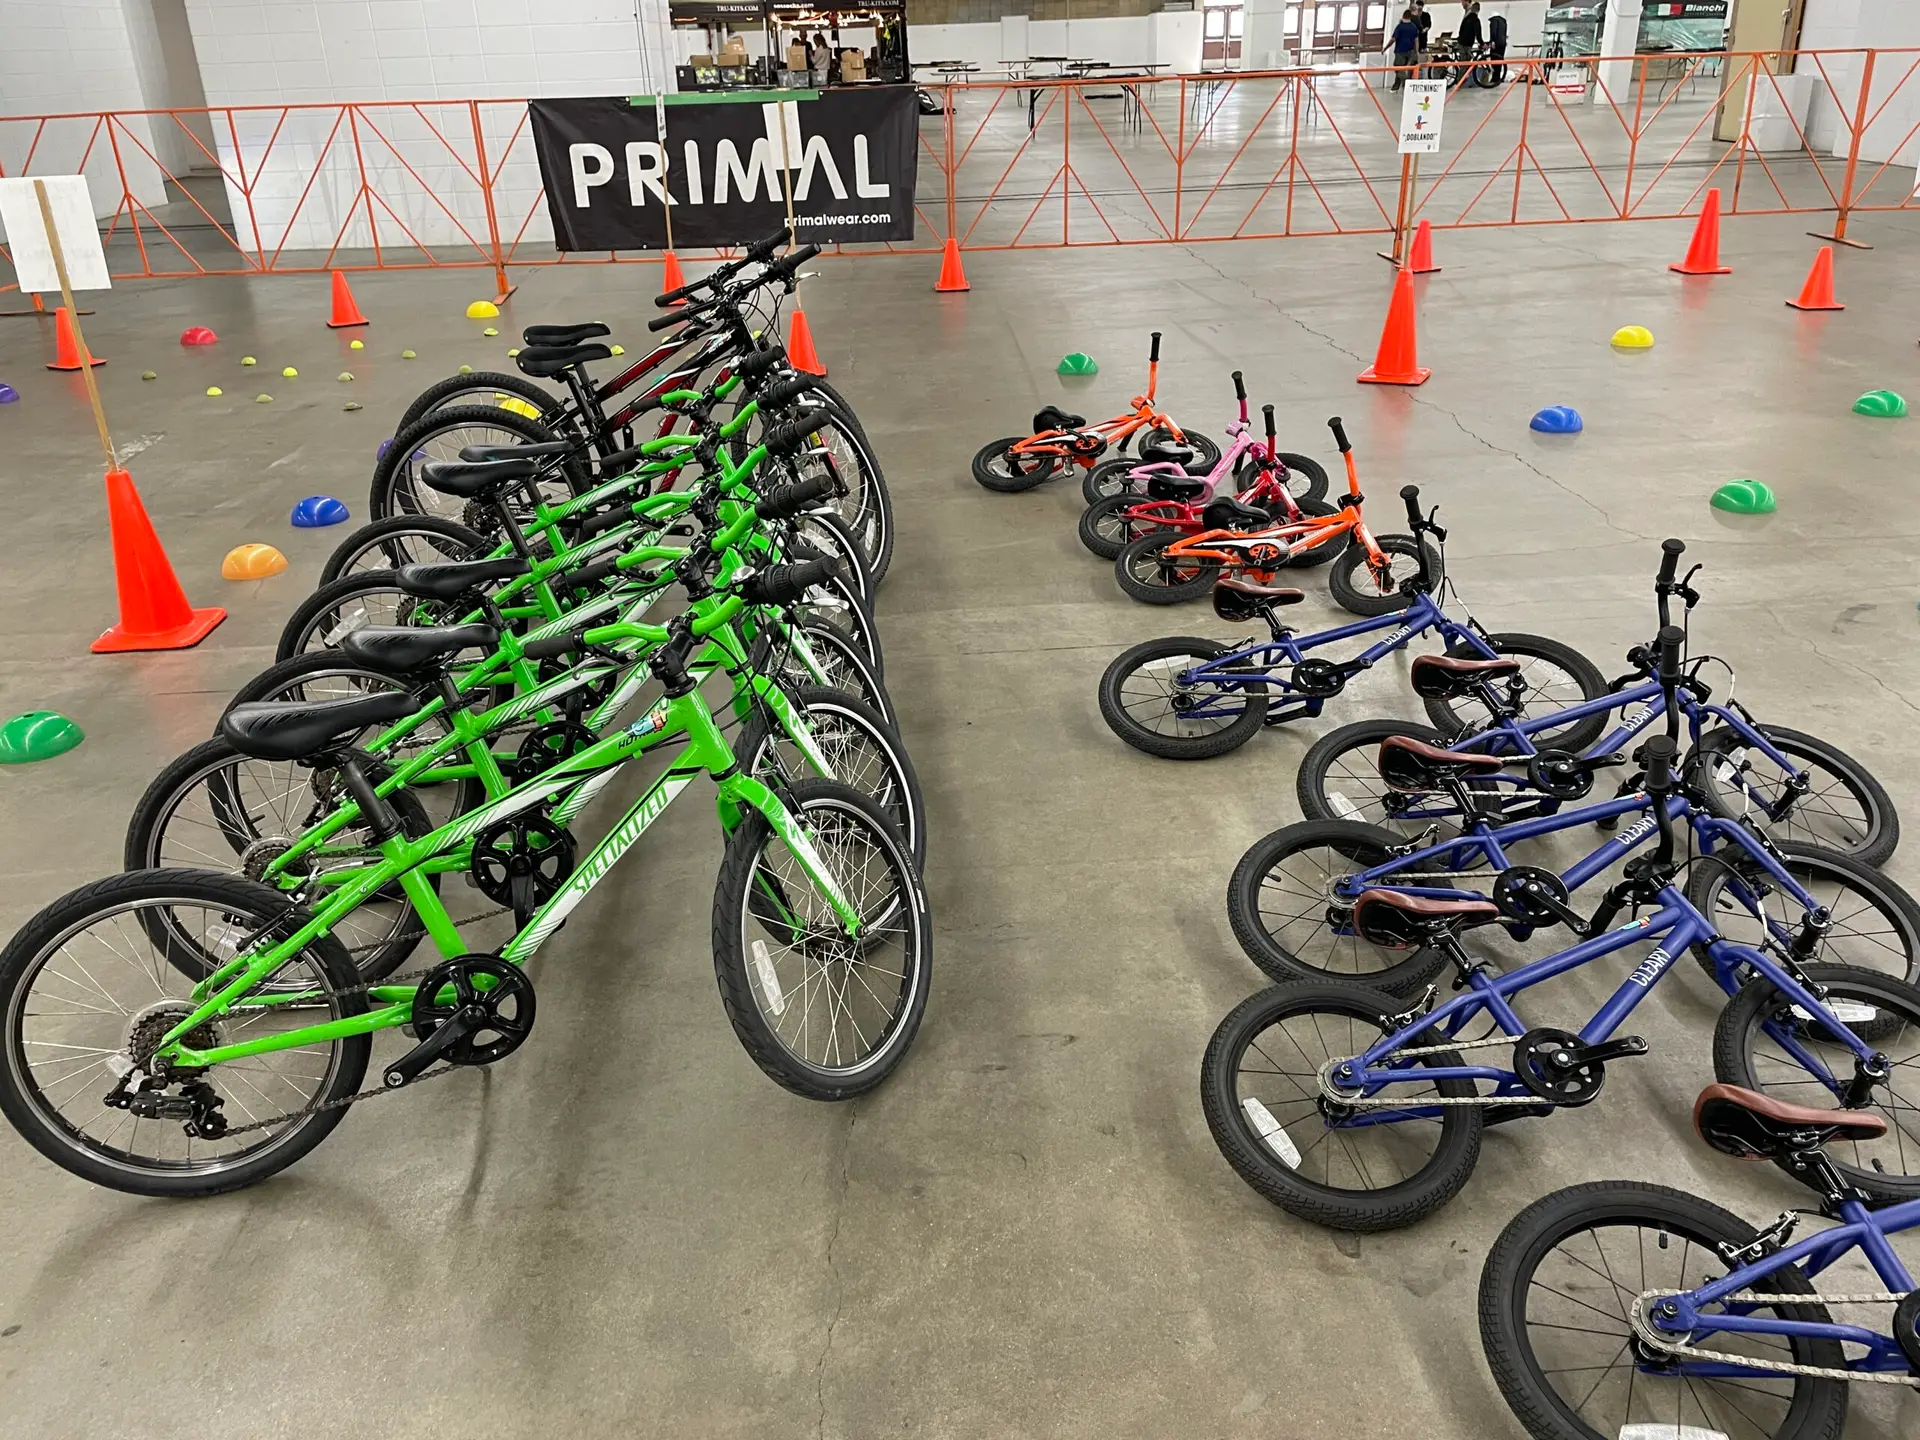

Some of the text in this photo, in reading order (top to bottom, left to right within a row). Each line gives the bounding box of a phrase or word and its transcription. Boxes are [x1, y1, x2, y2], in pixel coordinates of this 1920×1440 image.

[1685, 4, 1725, 12] Bianchi
[569, 134, 890, 208] PRIMAL
[784, 213, 891, 228] primalwear.com
[1382, 625, 1411, 645] CLEARY
[1620, 706, 1654, 732] CLEARY
[573, 785, 668, 894] SPECIALIZED
[1614, 815, 1657, 845] CLEARY
[1629, 947, 1671, 987] CLEARY
